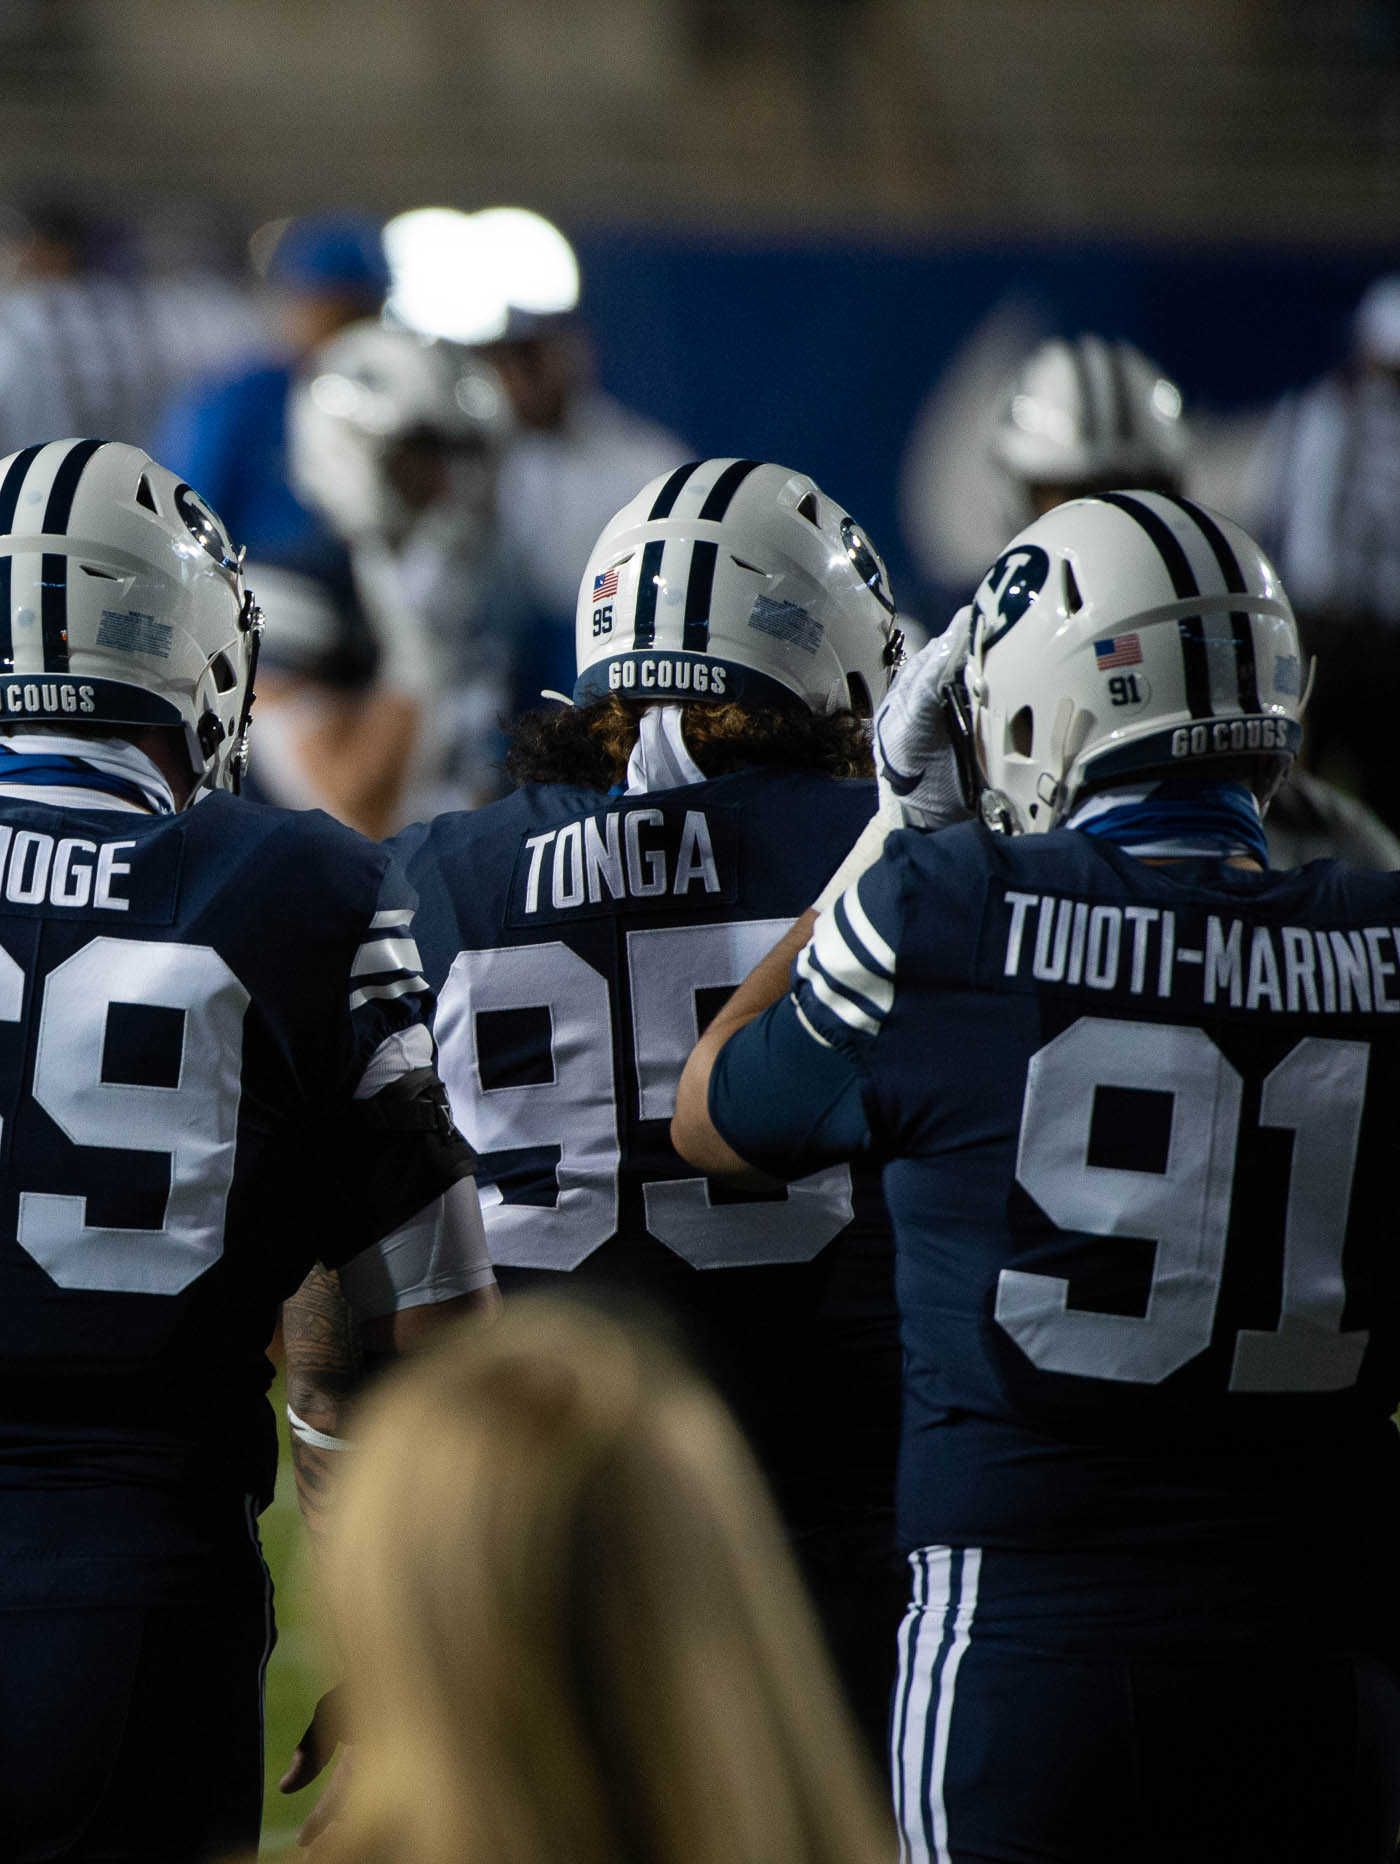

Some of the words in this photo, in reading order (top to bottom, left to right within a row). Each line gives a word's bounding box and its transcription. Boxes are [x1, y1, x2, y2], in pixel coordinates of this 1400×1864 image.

[592, 604, 613, 637] 95
[608, 660, 636, 690] GO
[641, 659, 727, 694] COUGS
[1108, 673, 1141, 706] 91
[7, 684, 95, 713] COUGS
[1171, 724, 1208, 758] GO
[1213, 719, 1288, 751] COUGS
[524, 808, 721, 914] TONGA
[1003, 891, 1400, 1014] TUIOTI-MARINE
[433, 917, 855, 1273] 95
[994, 1015, 1371, 1393] 91
